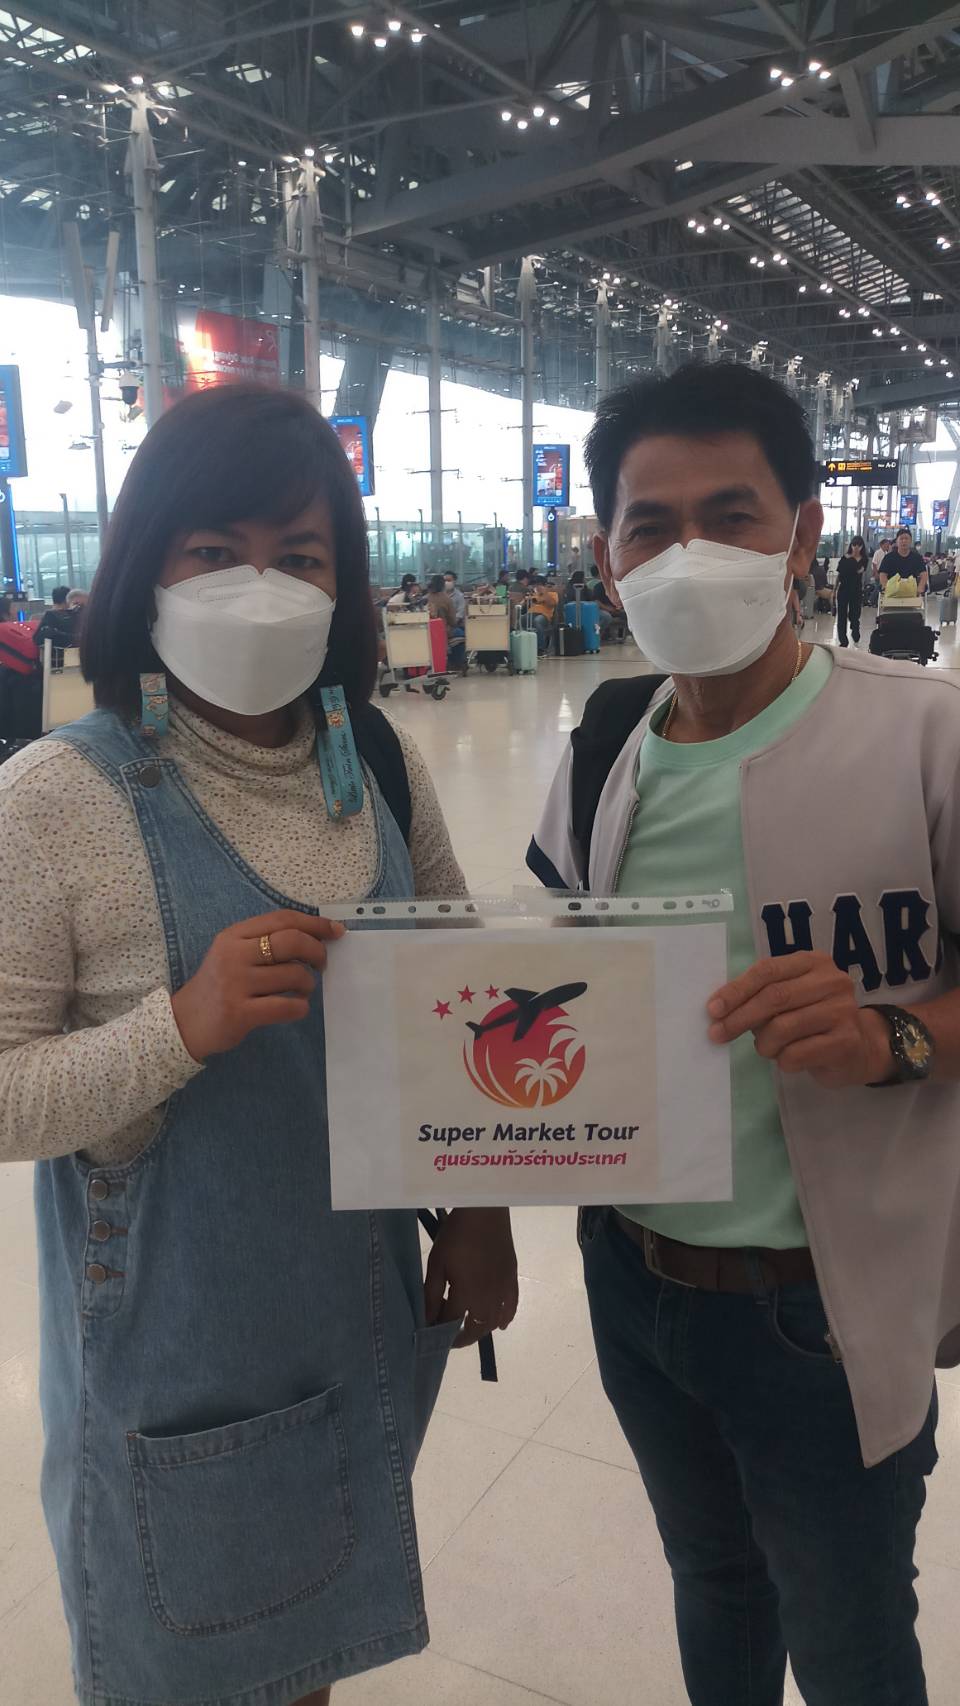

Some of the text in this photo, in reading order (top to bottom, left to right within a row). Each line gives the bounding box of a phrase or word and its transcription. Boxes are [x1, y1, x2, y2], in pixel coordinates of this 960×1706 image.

[418, 1122, 639, 1147] Super Market Tour
[433, 1149, 627, 1172] ศูนย์รวมทัวร์ต่างประเทศ
